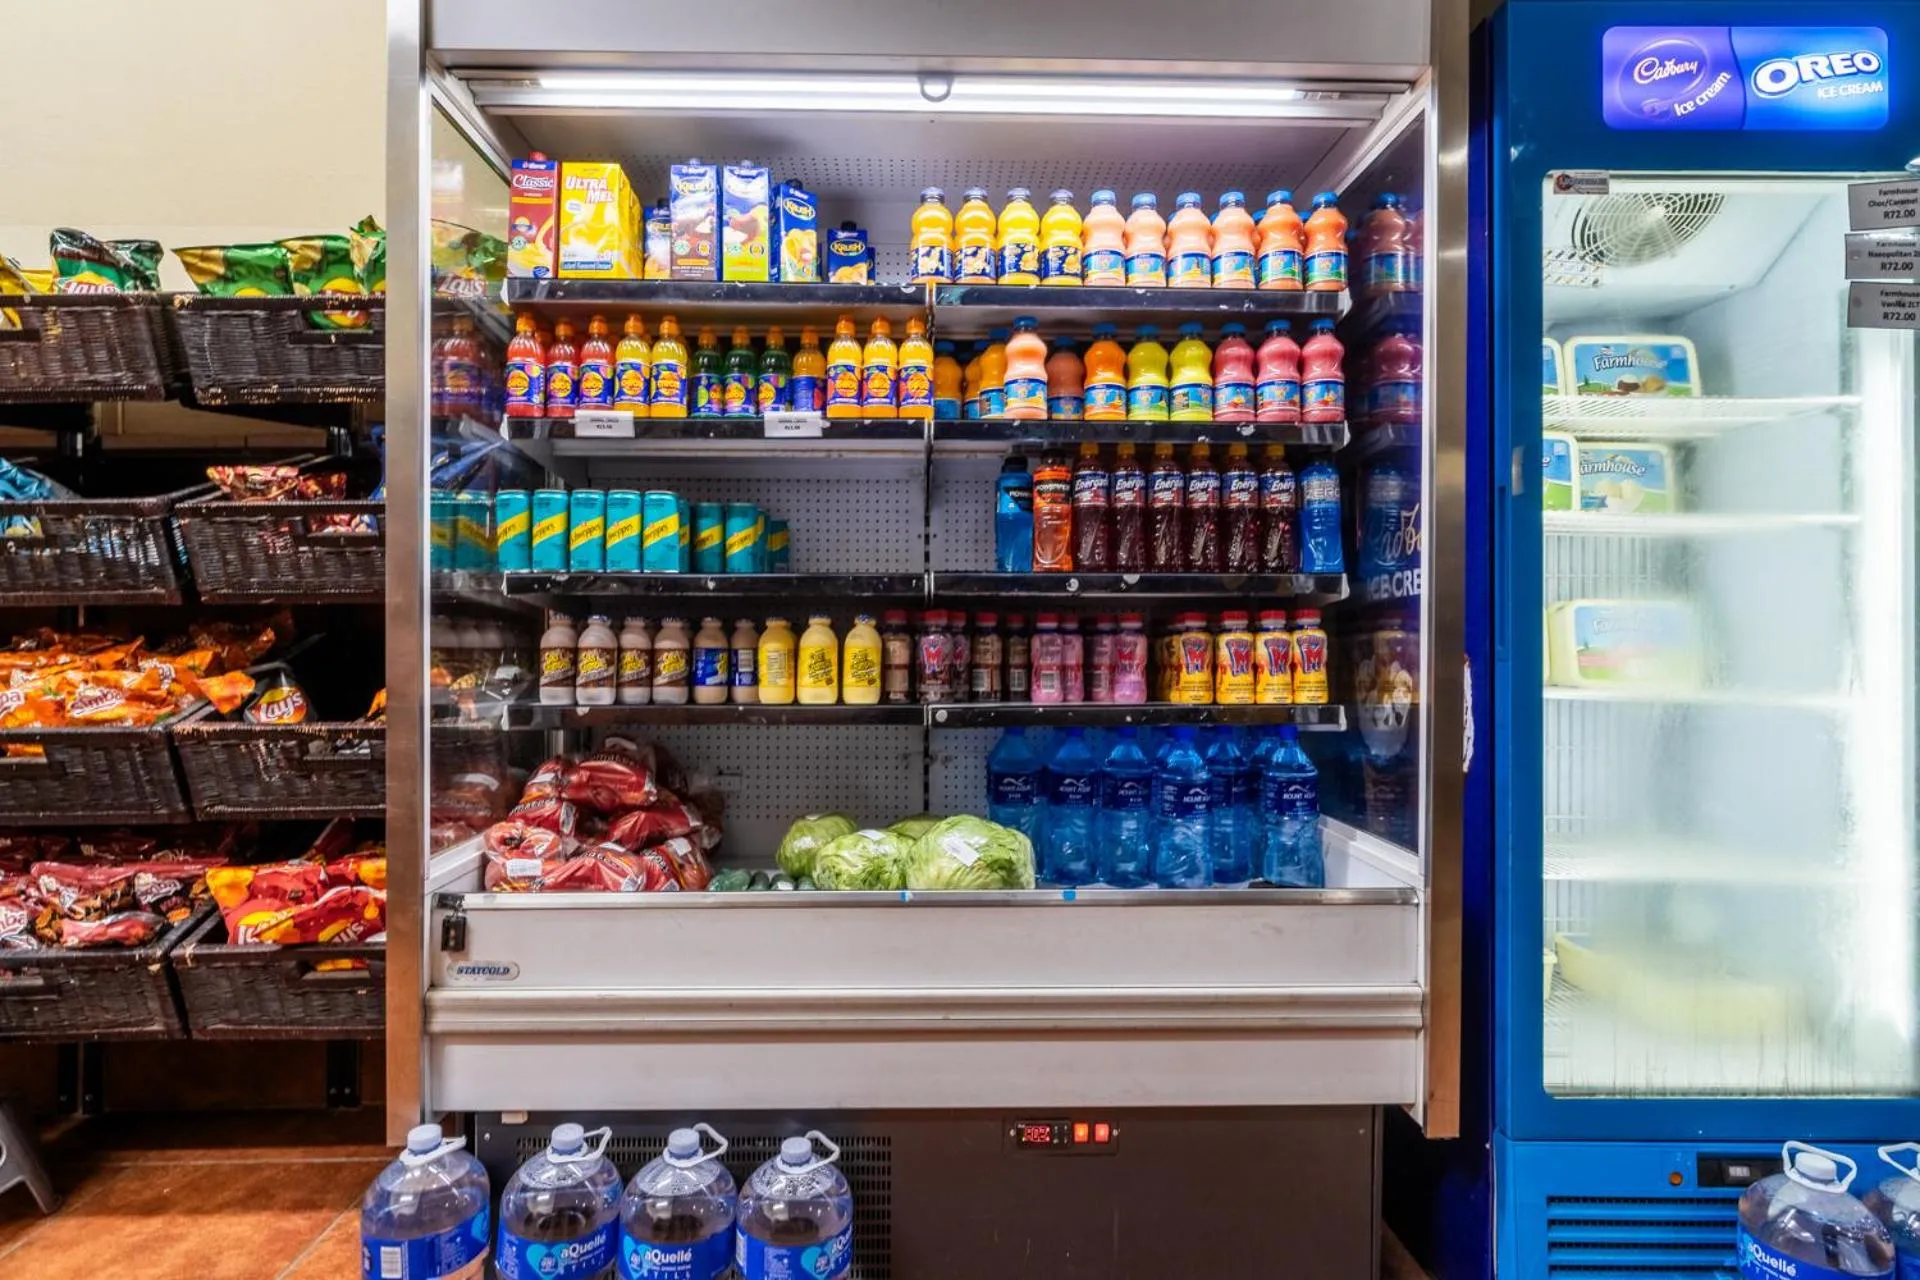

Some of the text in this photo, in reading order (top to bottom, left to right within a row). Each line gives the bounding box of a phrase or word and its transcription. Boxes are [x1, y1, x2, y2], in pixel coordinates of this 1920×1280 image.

[1633, 56, 1698, 85] Cadbury
[1753, 50, 1881, 97] OREO
[1673, 72, 1731, 117] Ice cream
[1817, 80, 1885, 99] ICE CREAM
[565, 175, 608, 192] ULTRA
[1878, 187, 1919, 197] Farmhouse
[1883, 208, 1916, 219] R72.00
[1880, 262, 1914, 272] R72.00
[1879, 288, 1920, 298] Farmhouse
[1883, 311, 1916, 322] R72.00
[1580, 459, 1646, 478] armhouse
[456, 965, 511, 977] STAYCOLD
[644, 1247, 692, 1265] aQuellé
